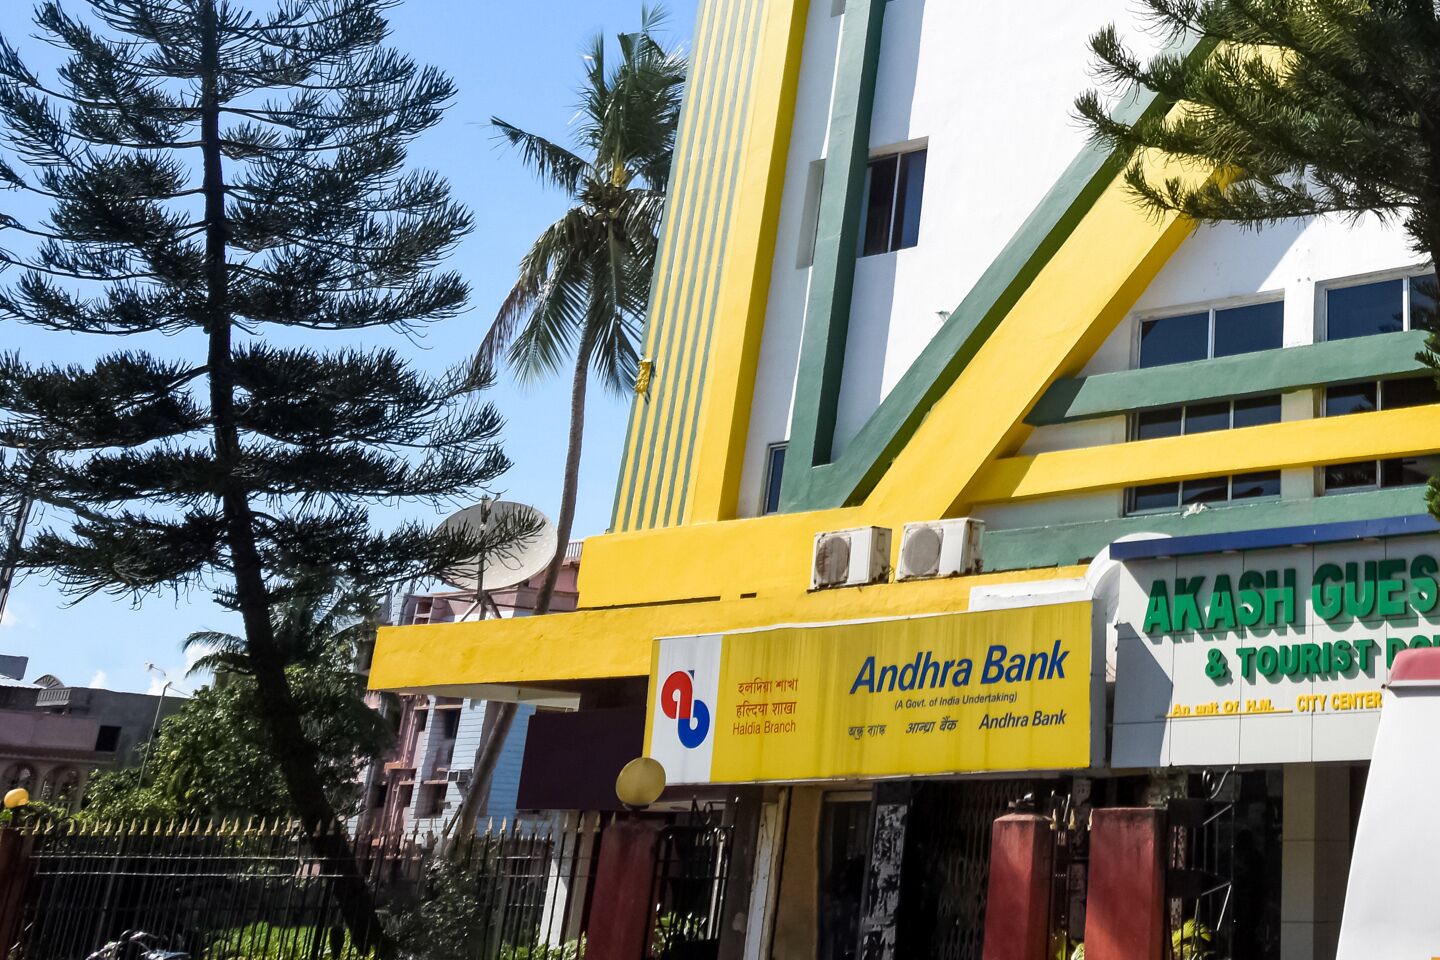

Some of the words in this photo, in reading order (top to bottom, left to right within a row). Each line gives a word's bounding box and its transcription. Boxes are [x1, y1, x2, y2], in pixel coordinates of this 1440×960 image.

[1142, 568, 1297, 635] AKASH
[850, 651, 973, 695] Andhra
[980, 640, 1070, 685] Bank
[1204, 648, 1226, 679] &
[1236, 639, 1374, 678] TOURIST
[775, 678, 798, 692] শাখা
[772, 701, 797, 715] शाखा
[894, 699, 903, 711] (A
[905, 699, 926, 709] Govt.
[929, 697, 938, 707] of
[940, 696, 960, 706] India
[962, 691, 1018, 704] Undertaking)
[1172, 703, 1190, 716] An
[1194, 701, 1219, 715] unit
[1223, 700, 1241, 713] Of
[1245, 699, 1275, 712] H.M.
[1296, 694, 1327, 713] CITY
[1331, 691, 1382, 711] CENTER
[732, 721, 761, 735] Haldia
[764, 720, 796, 734] Branch
[978, 712, 1028, 730] Andhra
[1032, 709, 1067, 727] Bank
